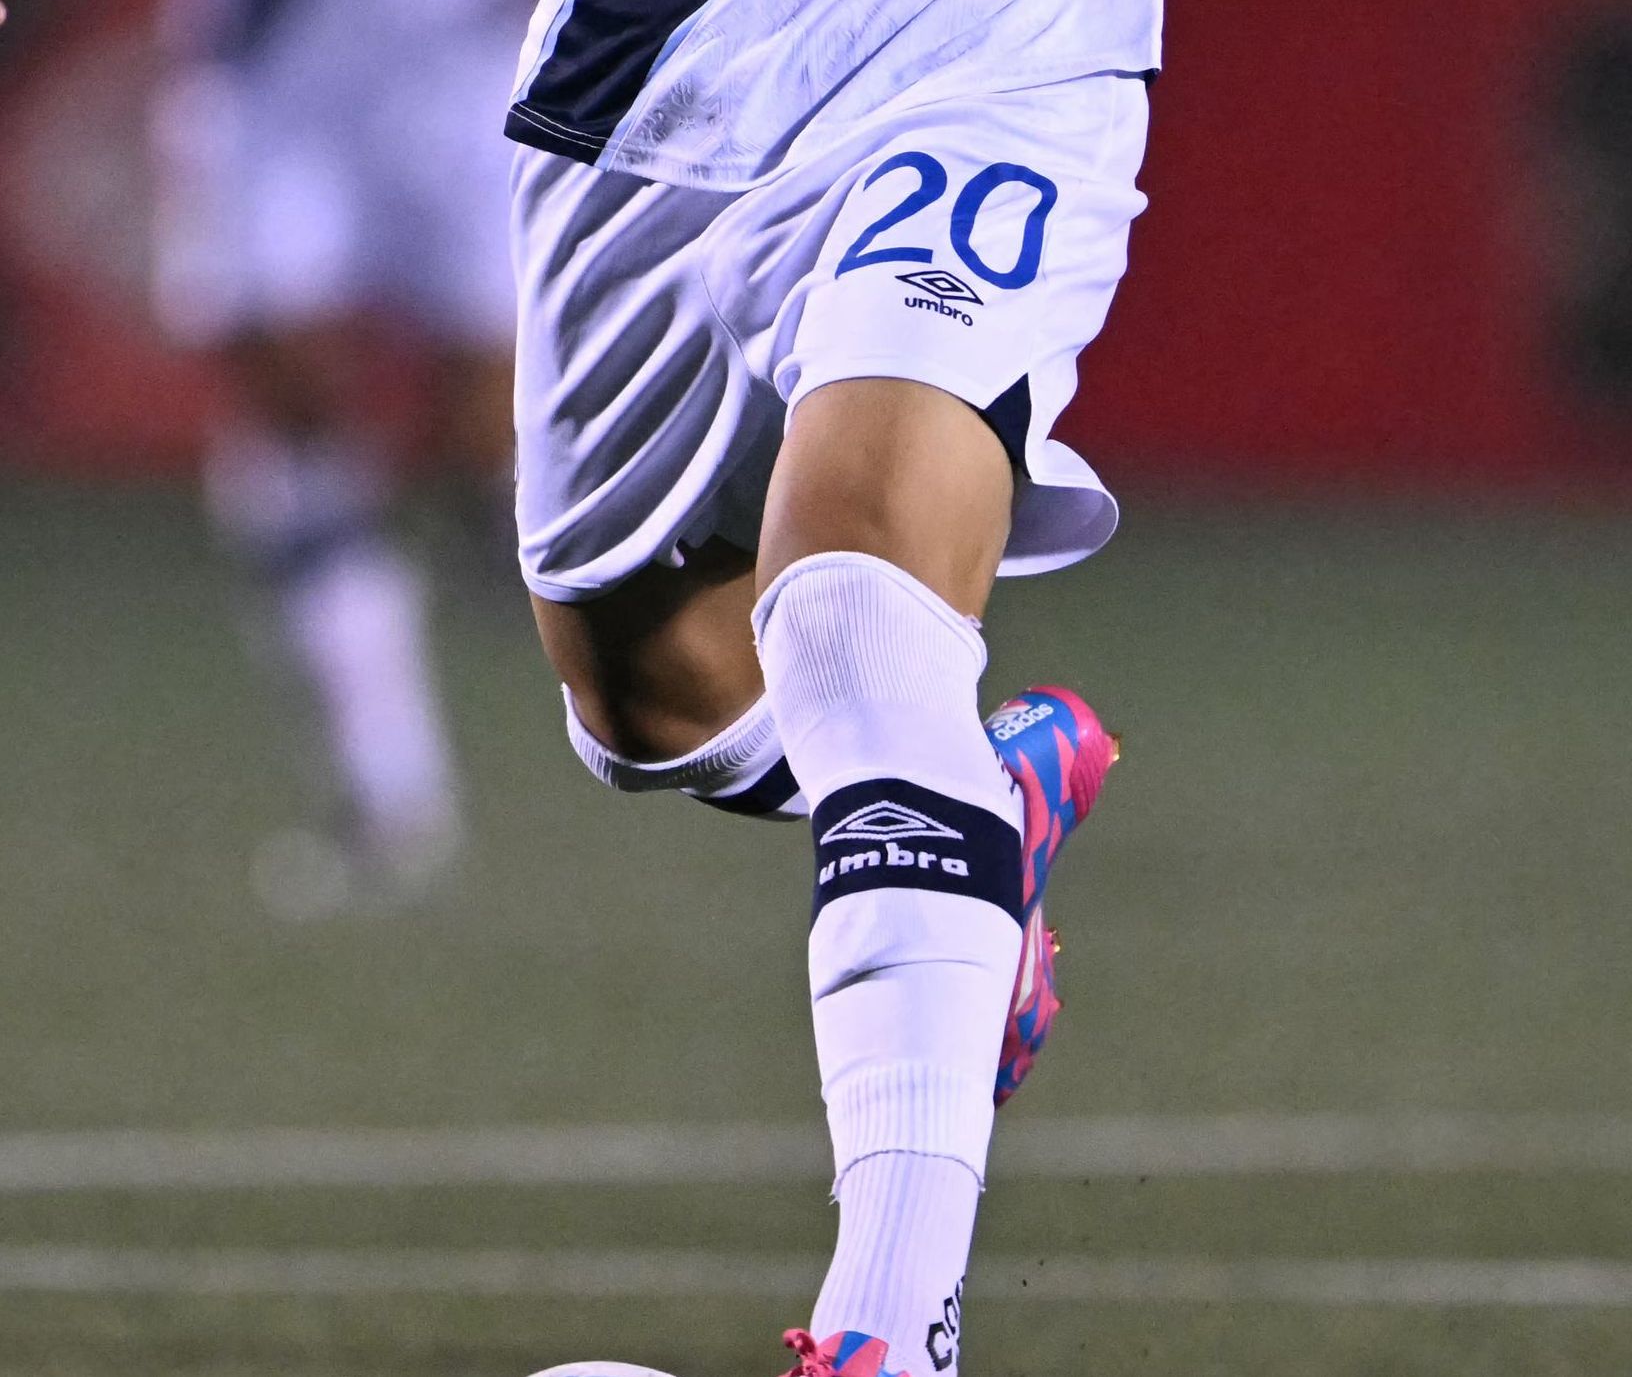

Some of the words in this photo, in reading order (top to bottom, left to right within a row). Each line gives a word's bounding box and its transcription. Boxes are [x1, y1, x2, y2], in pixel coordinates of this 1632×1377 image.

[835, 151, 1058, 290] 20
[904, 297, 974, 327] umbro
[994, 703, 1054, 741] adidas
[819, 842, 970, 885] umbro
